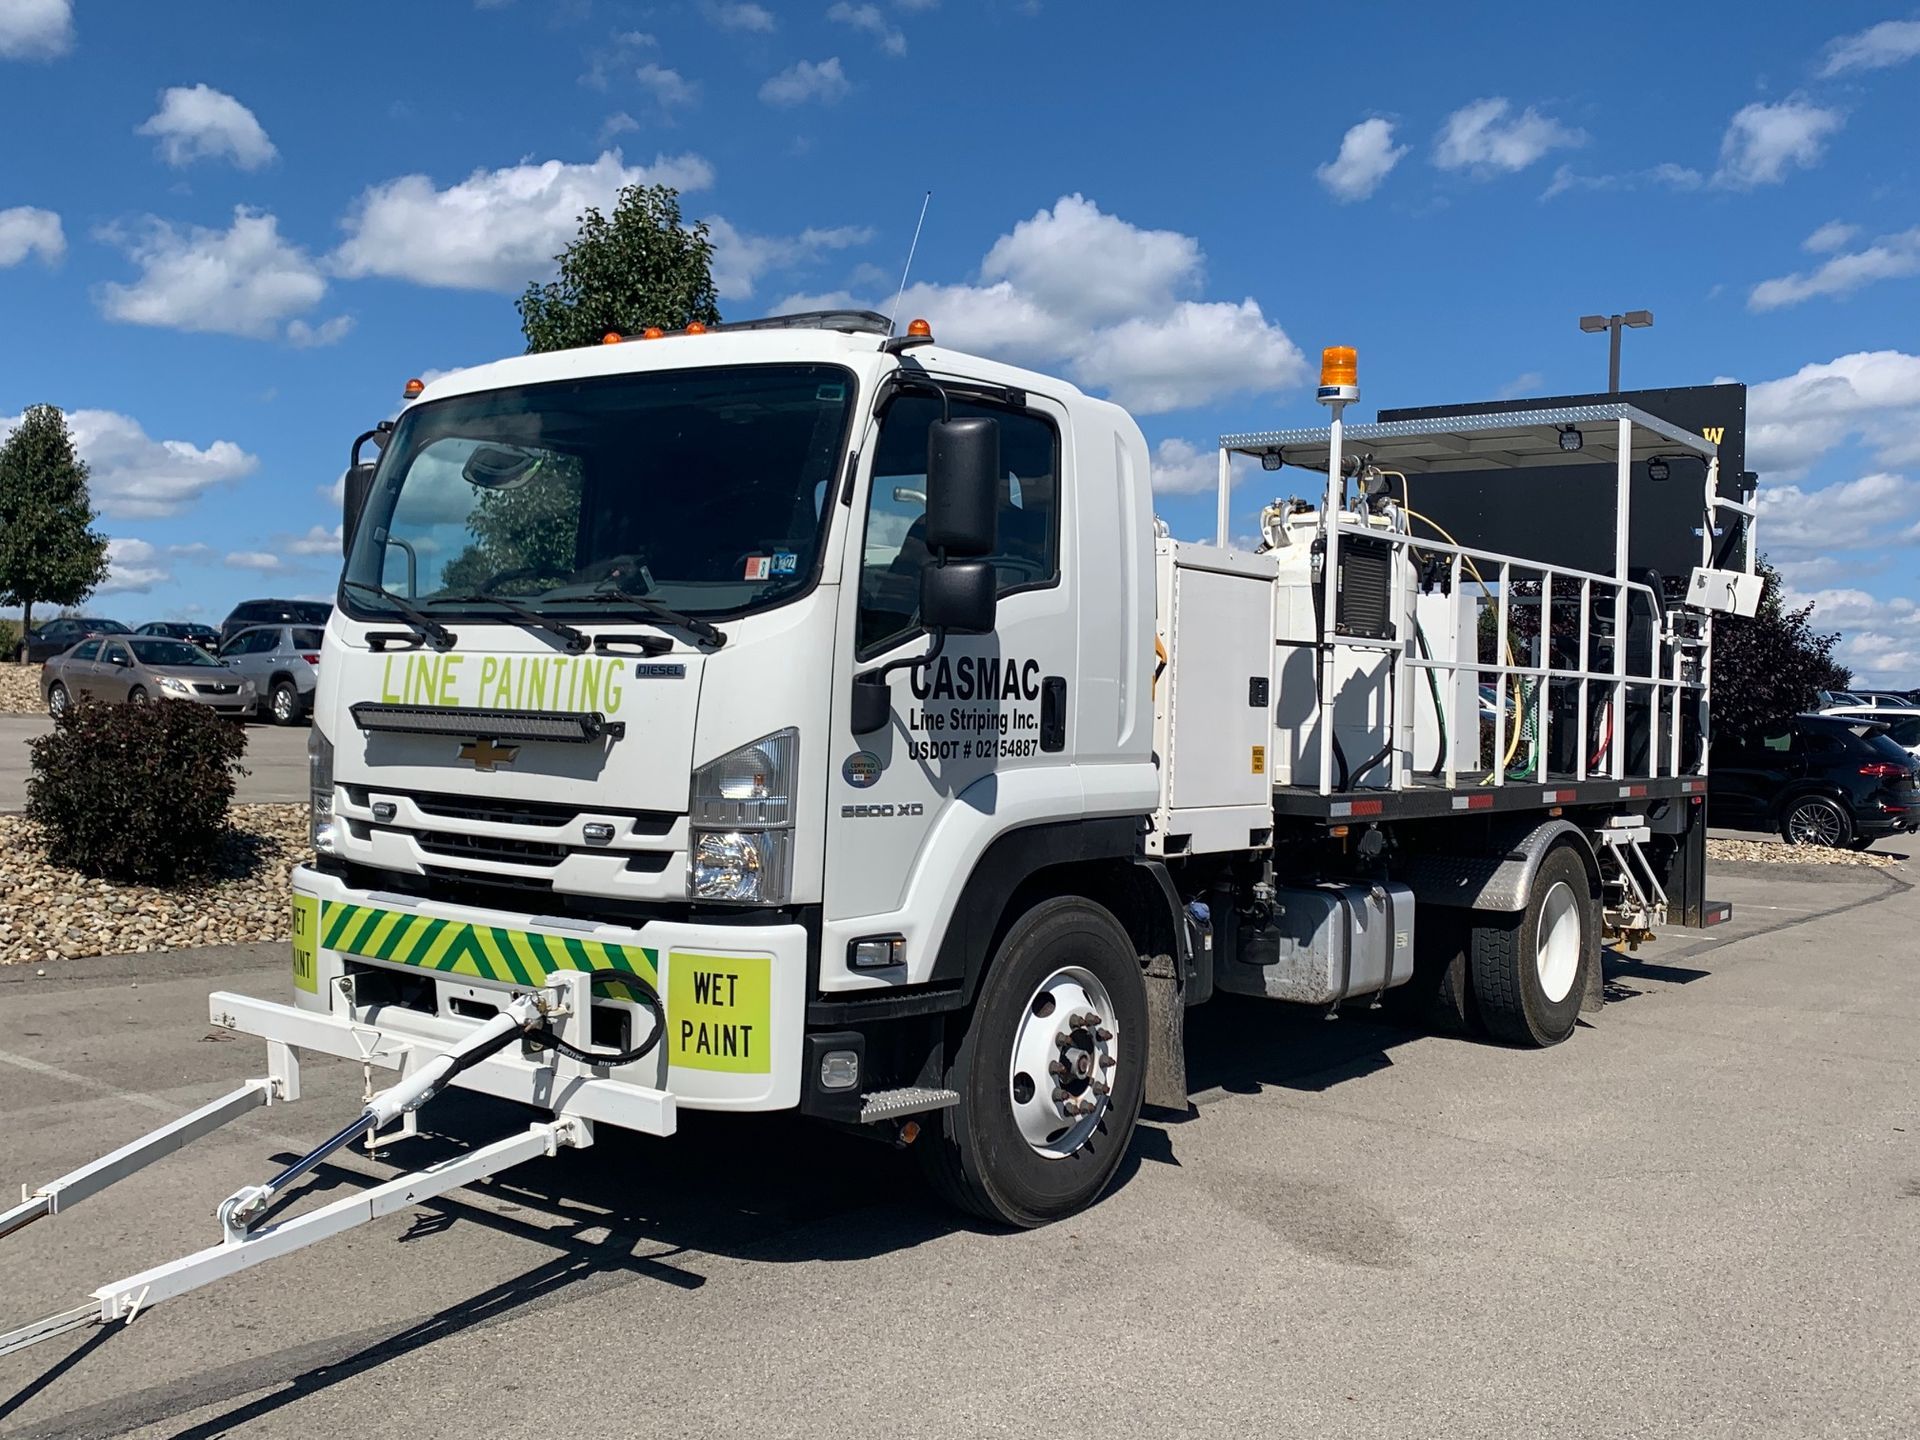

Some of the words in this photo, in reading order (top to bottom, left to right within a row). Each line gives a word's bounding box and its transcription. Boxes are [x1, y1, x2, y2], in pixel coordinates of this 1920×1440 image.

[381, 655, 464, 706] LINE
[477, 656, 625, 715] PAINTING
[637, 664, 683, 676] DIESEL
[910, 655, 1040, 701] CASMAC
[910, 707, 945, 731] Line
[949, 707, 1008, 735] Striping
[1013, 708, 1038, 730] Inc.
[908, 741, 960, 760] USDOT
[963, 740, 972, 759] #
[975, 739, 1038, 758] 02154887
[841, 804, 894, 818] 5500
[896, 803, 924, 817] XD
[693, 971, 738, 1007] WET
[681, 1019, 753, 1058] PAINT
